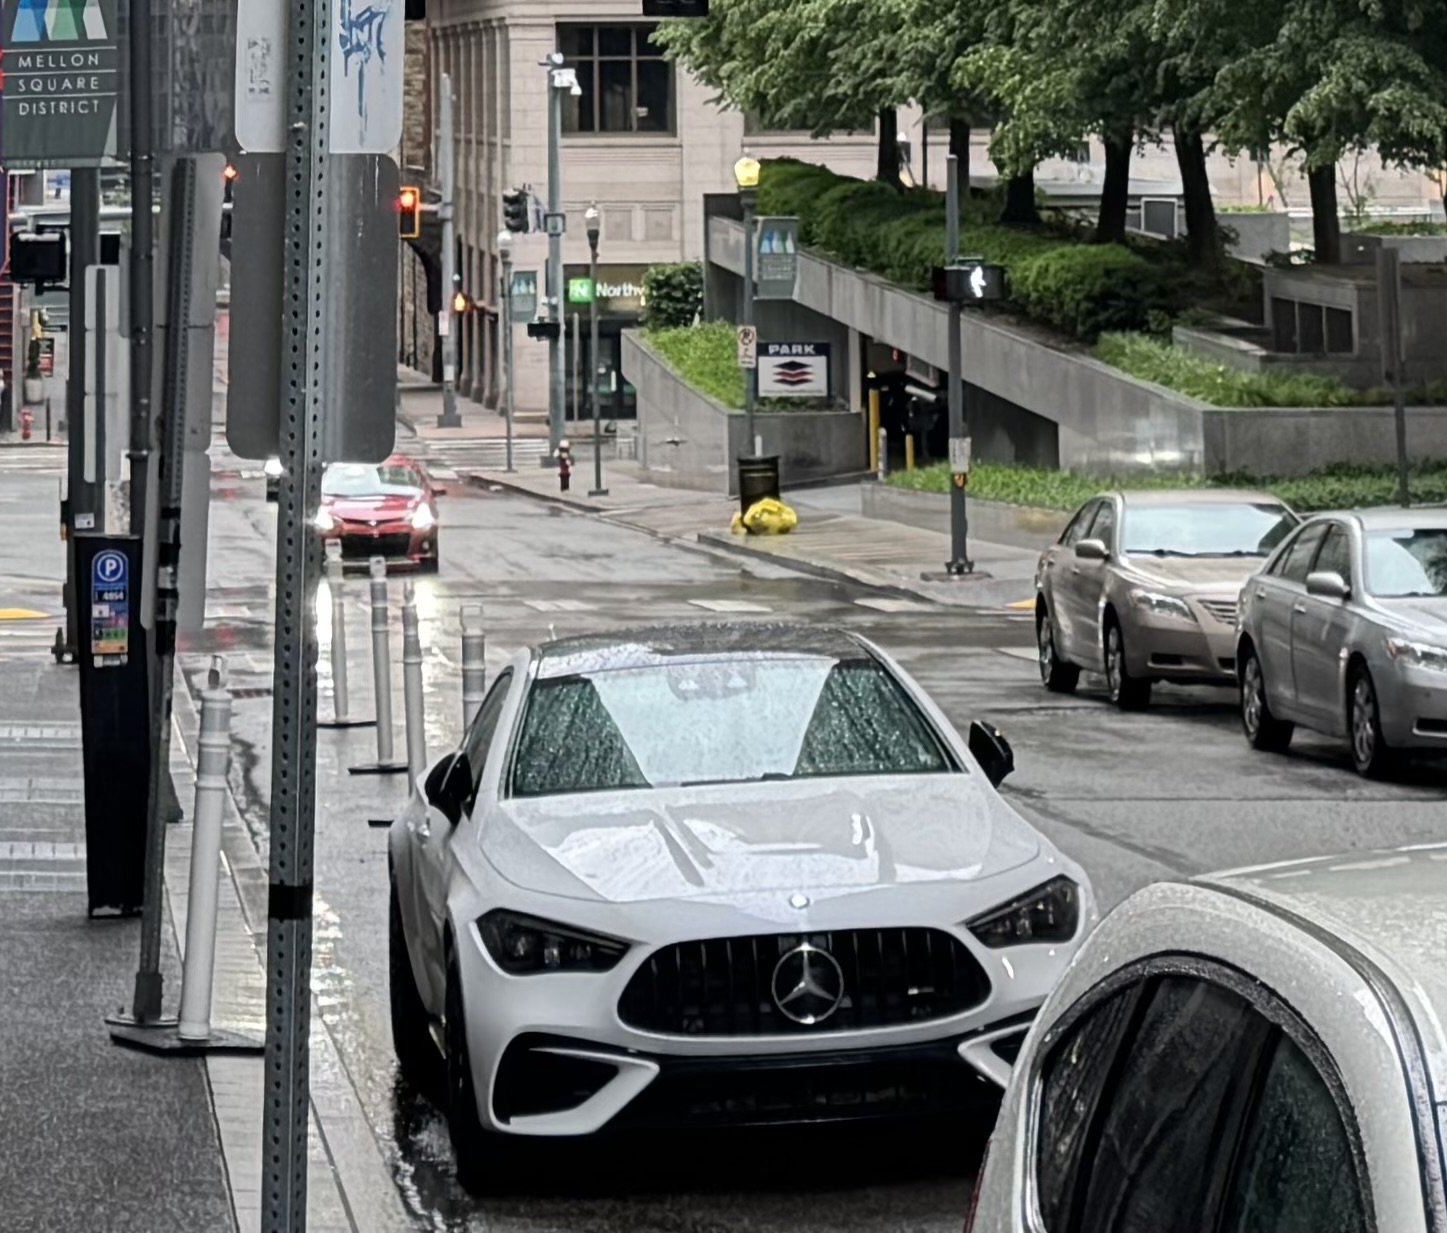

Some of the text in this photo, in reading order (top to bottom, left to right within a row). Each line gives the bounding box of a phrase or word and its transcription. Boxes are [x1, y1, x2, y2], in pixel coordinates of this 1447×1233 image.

[18, 53, 100, 69] MELLON
[17, 76, 100, 93] SQUARE
[18, 99, 101, 116] DISTRICT
[768, 344, 816, 356] PARK
[105, 558, 117, 577] P
